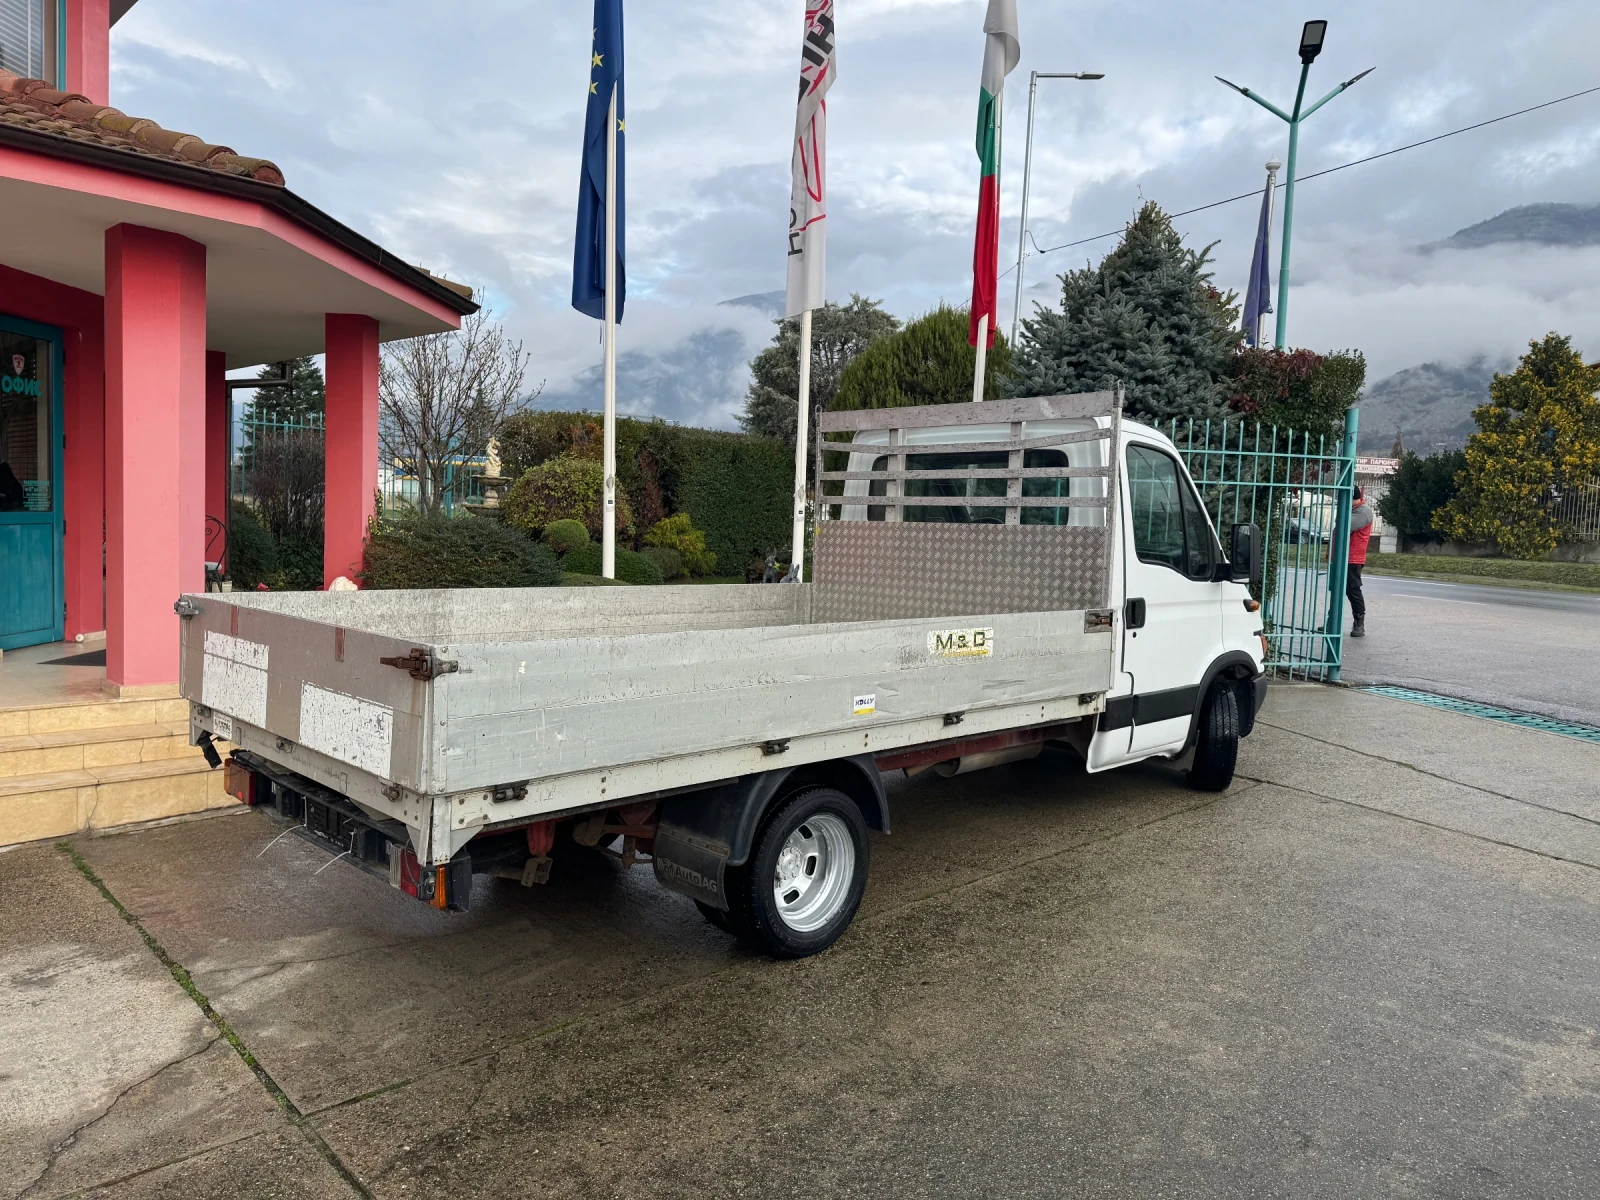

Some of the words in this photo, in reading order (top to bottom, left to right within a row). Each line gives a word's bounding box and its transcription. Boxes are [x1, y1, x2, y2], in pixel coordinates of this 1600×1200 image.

[2, 375, 42, 397] ОФИС
[936, 633, 953, 650] M
[702, 876, 718, 893] AG
